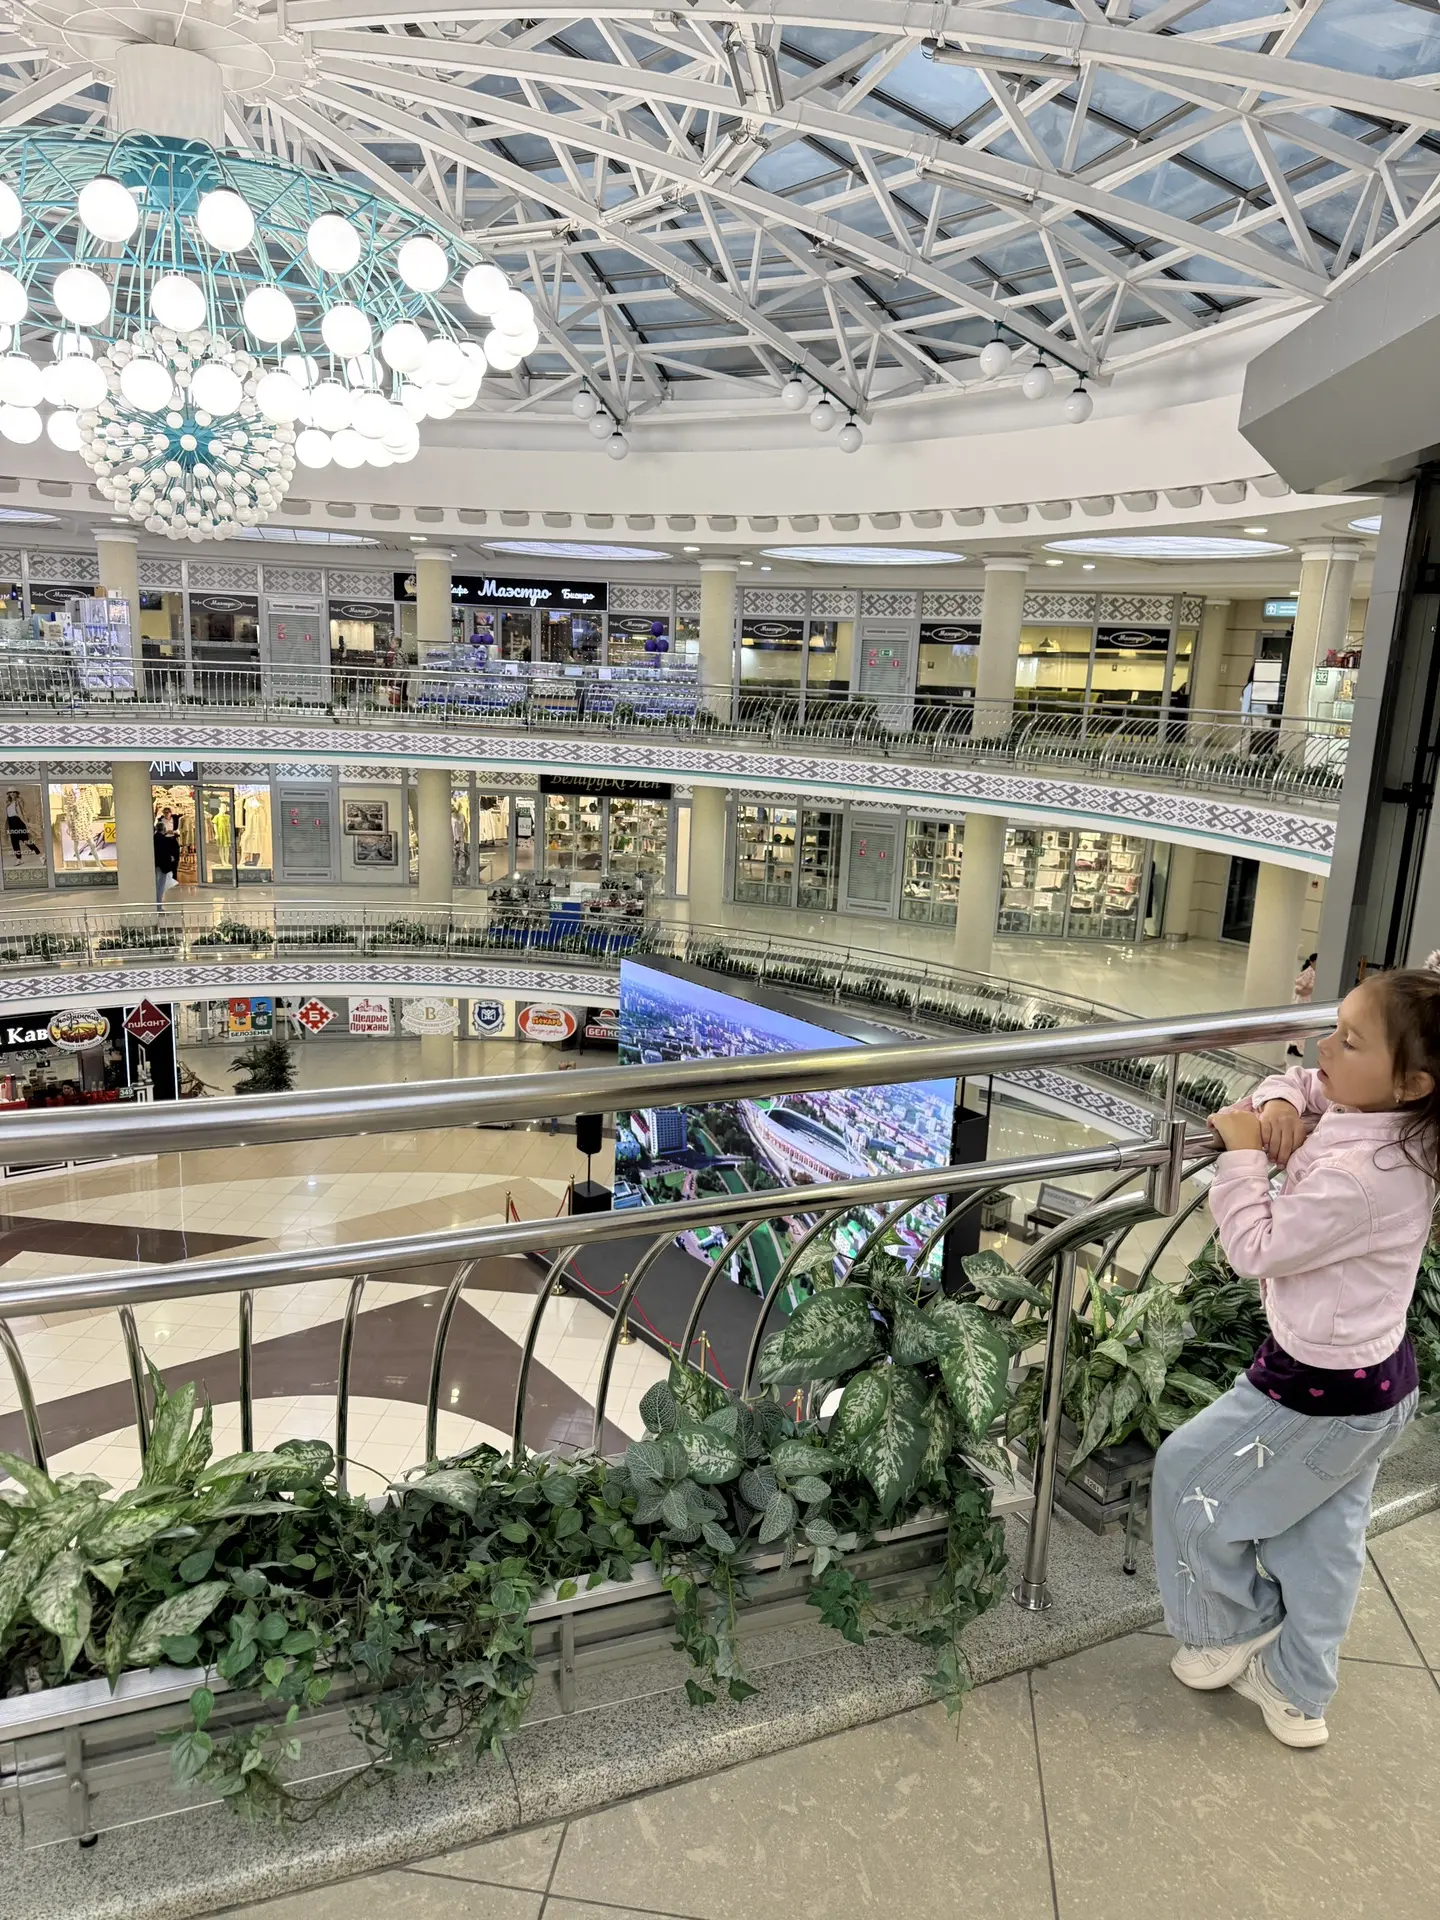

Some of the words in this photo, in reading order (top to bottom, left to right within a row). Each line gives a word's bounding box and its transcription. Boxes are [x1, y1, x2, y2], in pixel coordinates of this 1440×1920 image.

[478, 579, 552, 607] Маэстро
[562, 588, 596, 604] Бистро
[309, 1010, 321, 1021] Б
[352, 1013, 388, 1023] Щедрые
[350, 1023, 389, 1032] Пружаны
[7, 1027, 48, 1045] Кав
